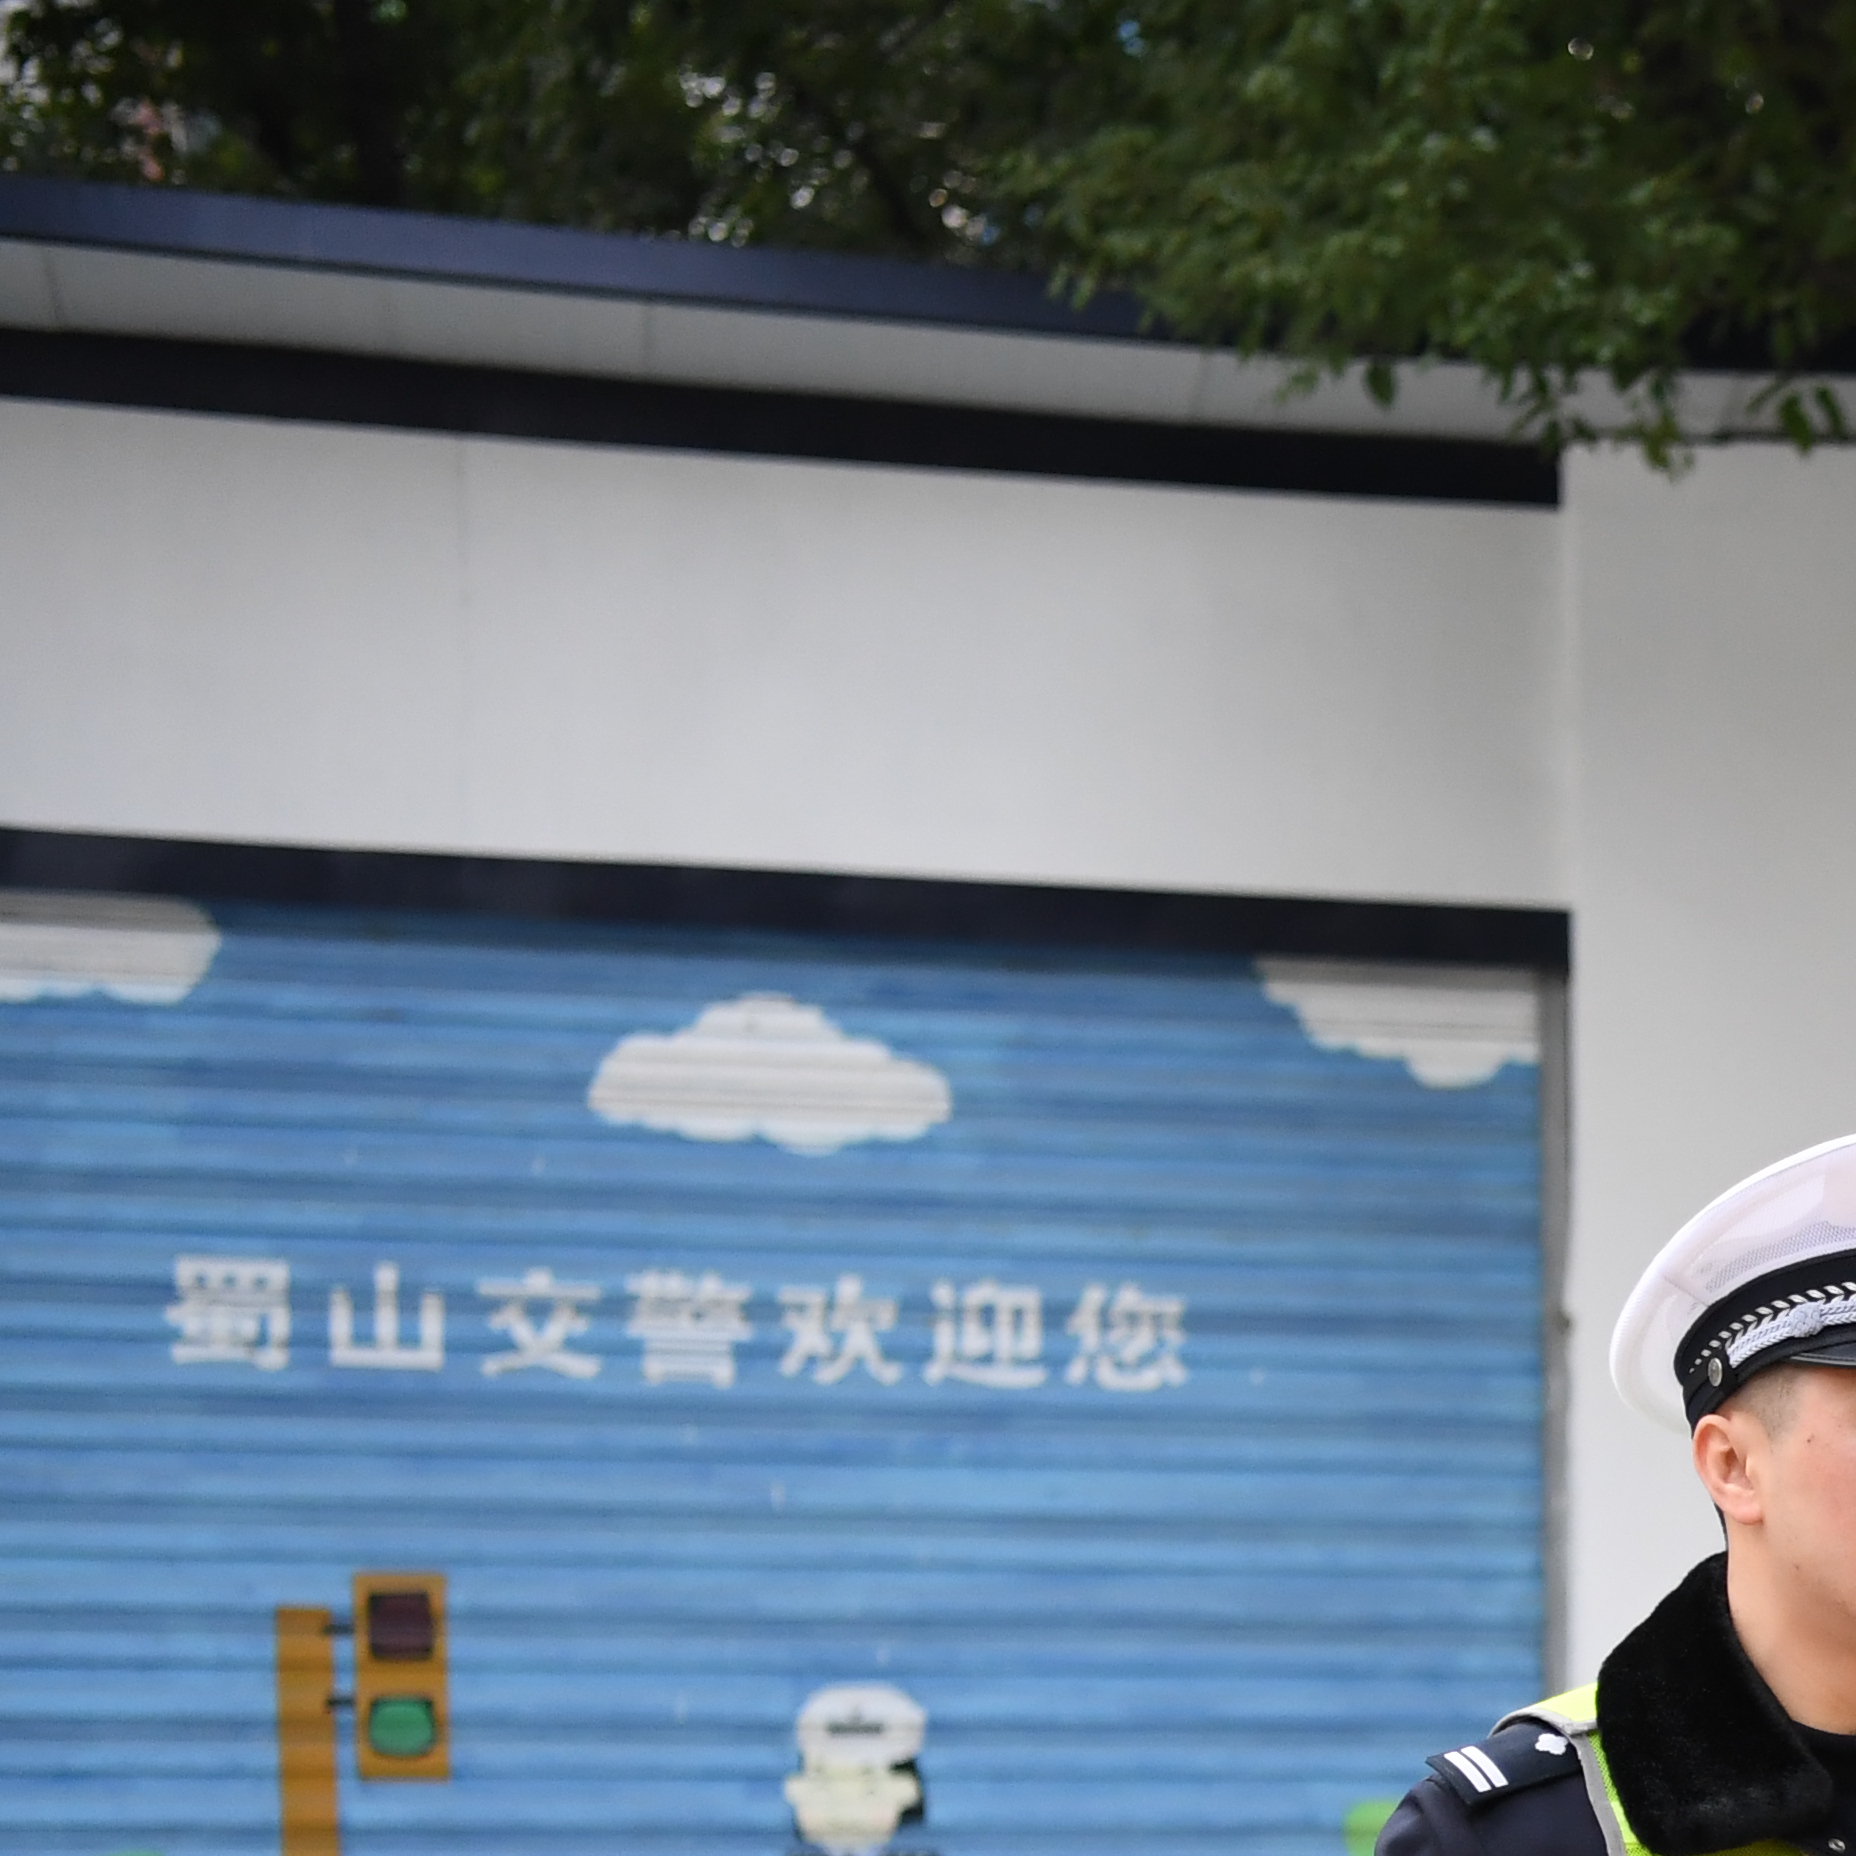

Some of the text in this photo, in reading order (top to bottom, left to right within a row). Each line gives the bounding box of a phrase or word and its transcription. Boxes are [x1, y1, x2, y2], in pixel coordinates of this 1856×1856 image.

[165, 1256, 1189, 1390] 蜀山交警欢迎您
